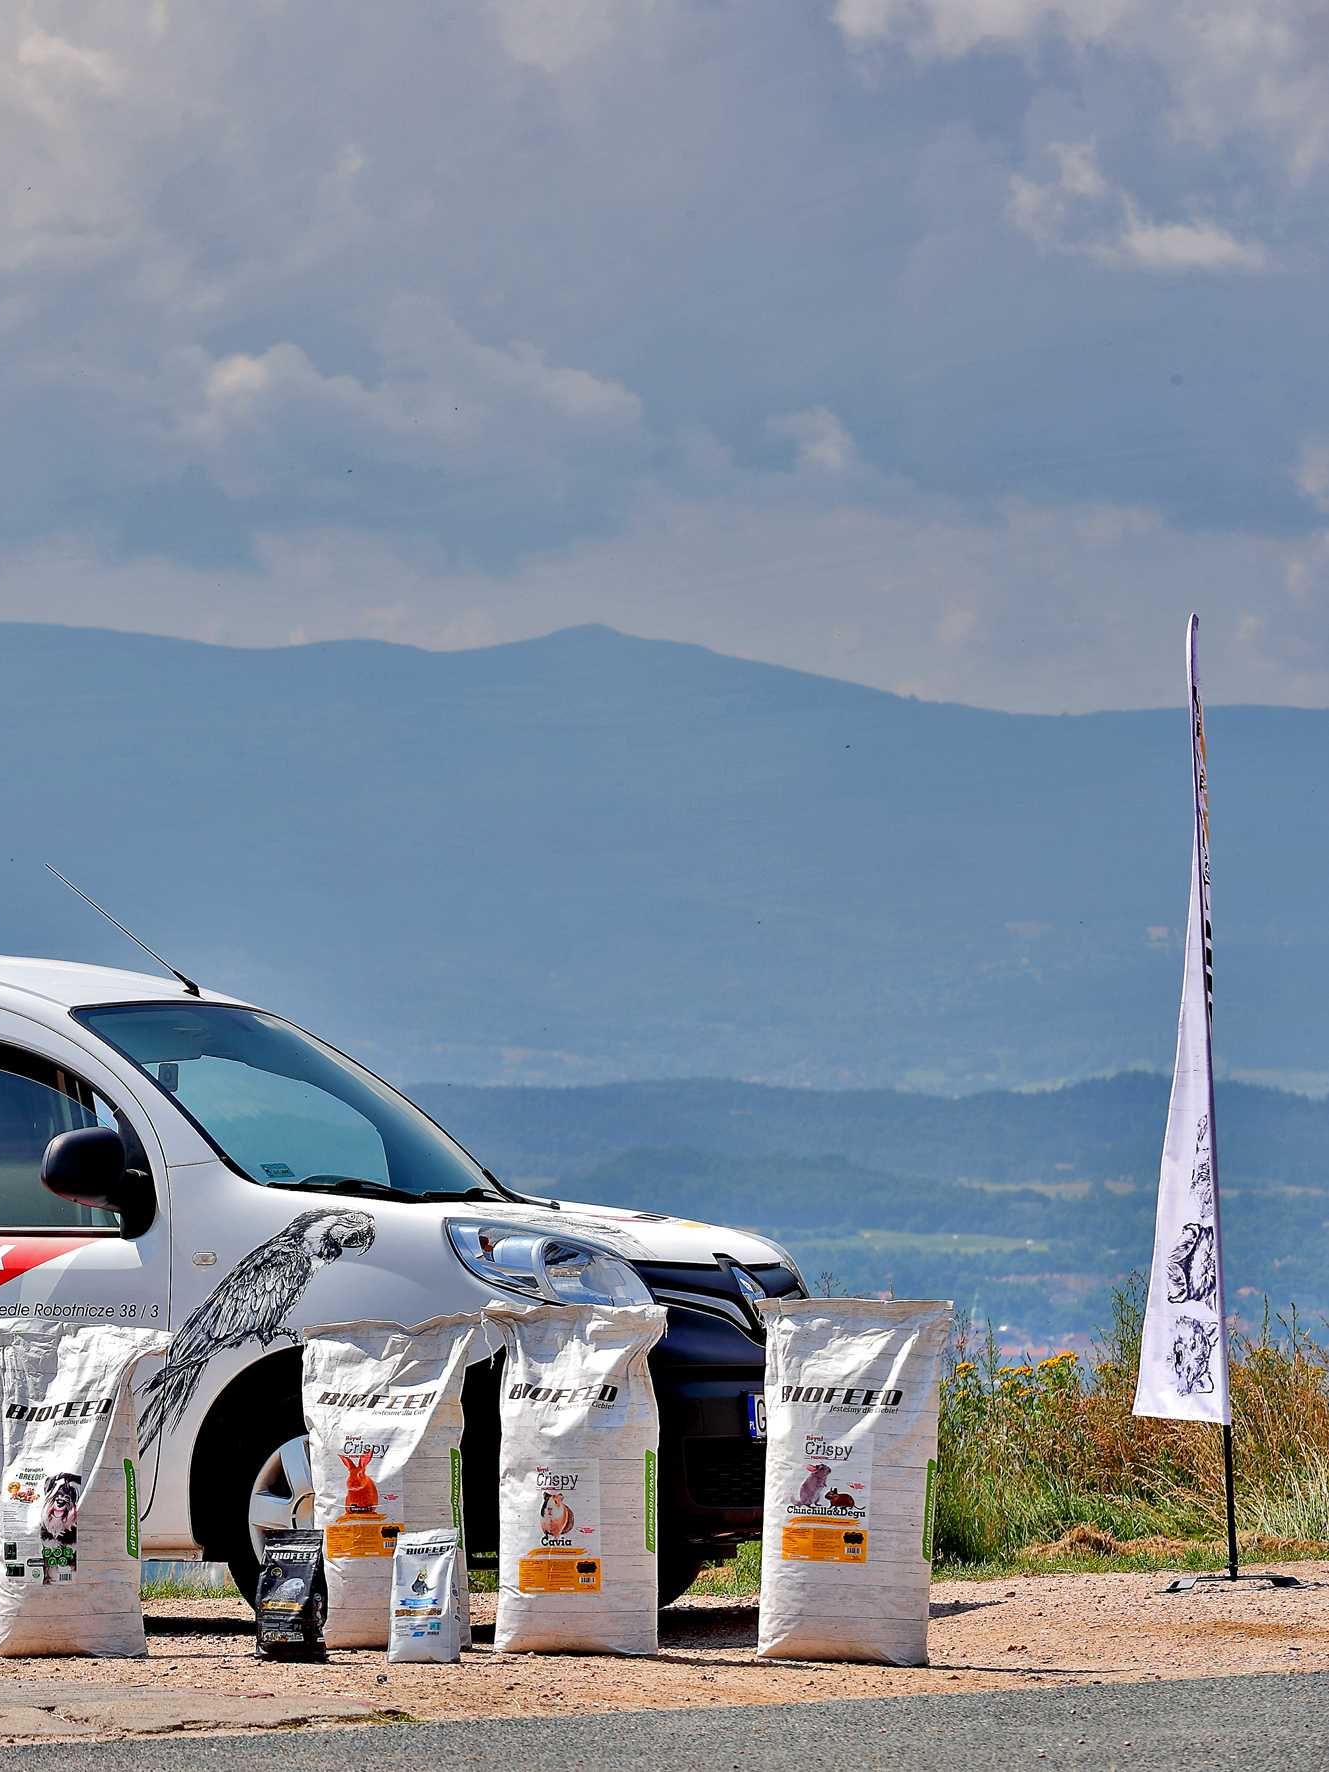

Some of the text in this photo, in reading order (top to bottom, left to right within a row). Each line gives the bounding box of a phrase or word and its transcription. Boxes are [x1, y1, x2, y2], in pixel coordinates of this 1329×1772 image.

[34, 1303, 114, 1318] Robotnicze
[119, 1305, 136, 1318] 38
[150, 1305, 159, 1318] 3
[509, 1383, 618, 1403] BIOFEED
[782, 1385, 903, 1407] BIOFEED
[6, 1398, 113, 1422] BIOFEED
[344, 1441, 389, 1458] Crispy
[805, 1441, 853, 1460] Crispy
[536, 1472, 578, 1489] Crispy
[787, 1506, 865, 1519] Chinchilla&Degu
[541, 1536, 572, 1547] Cavia
[272, 1552, 318, 1560] BIOFEED
